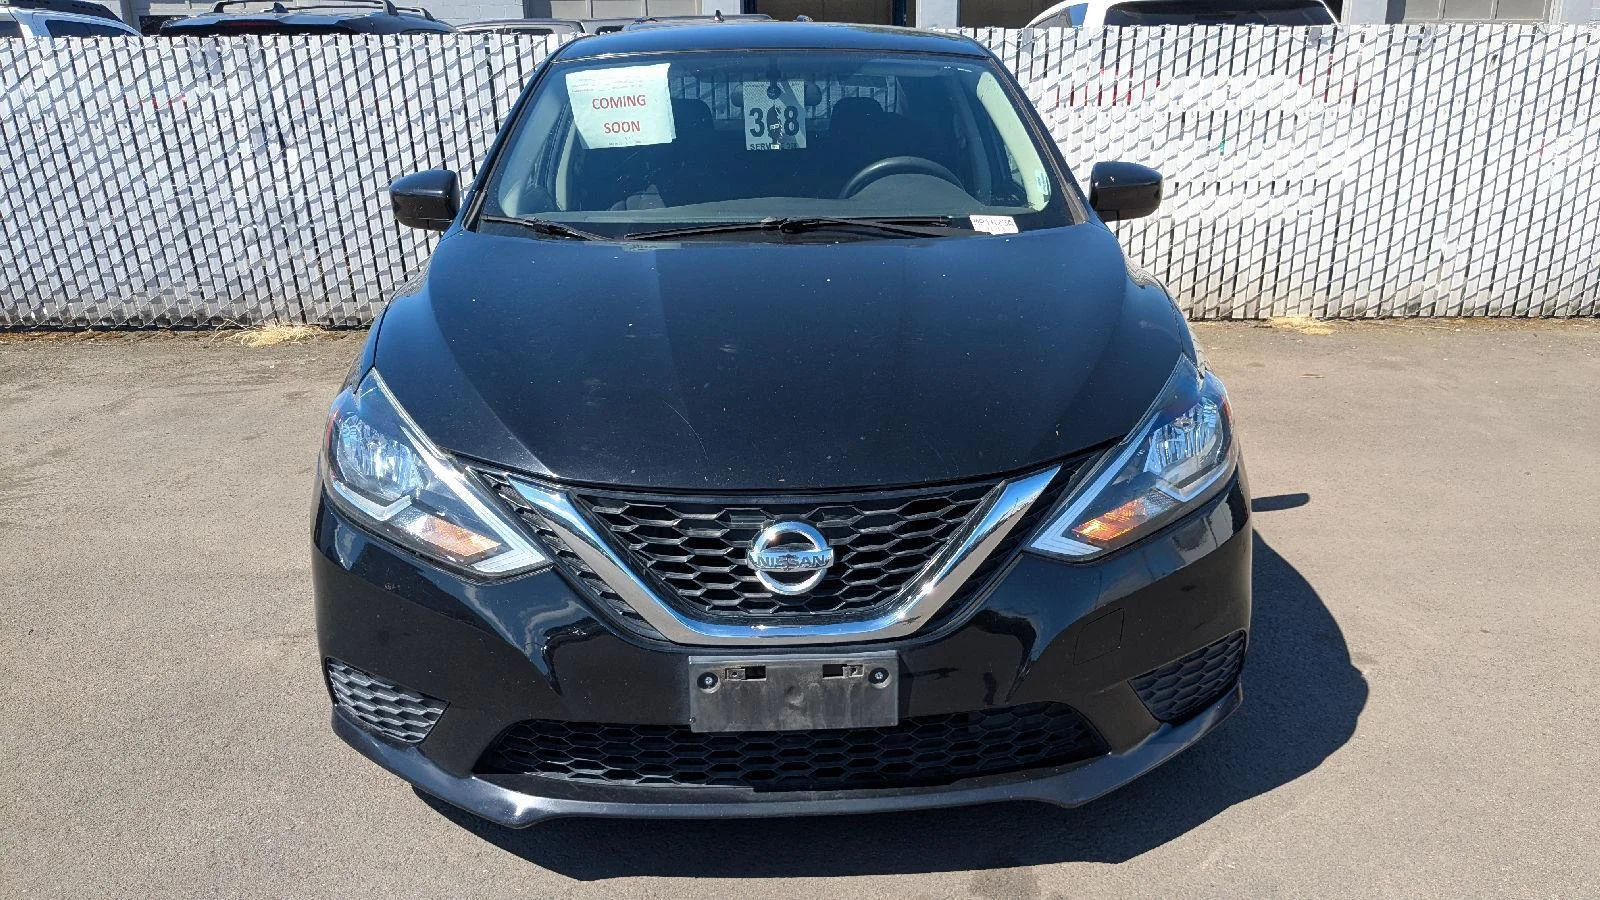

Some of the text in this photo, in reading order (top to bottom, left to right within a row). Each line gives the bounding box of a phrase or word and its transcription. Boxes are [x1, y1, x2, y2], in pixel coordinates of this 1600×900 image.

[592, 94, 646, 109] COMING
[603, 120, 641, 134] SOON
[749, 105, 799, 137] 38
[757, 554, 825, 568] NISSAN
